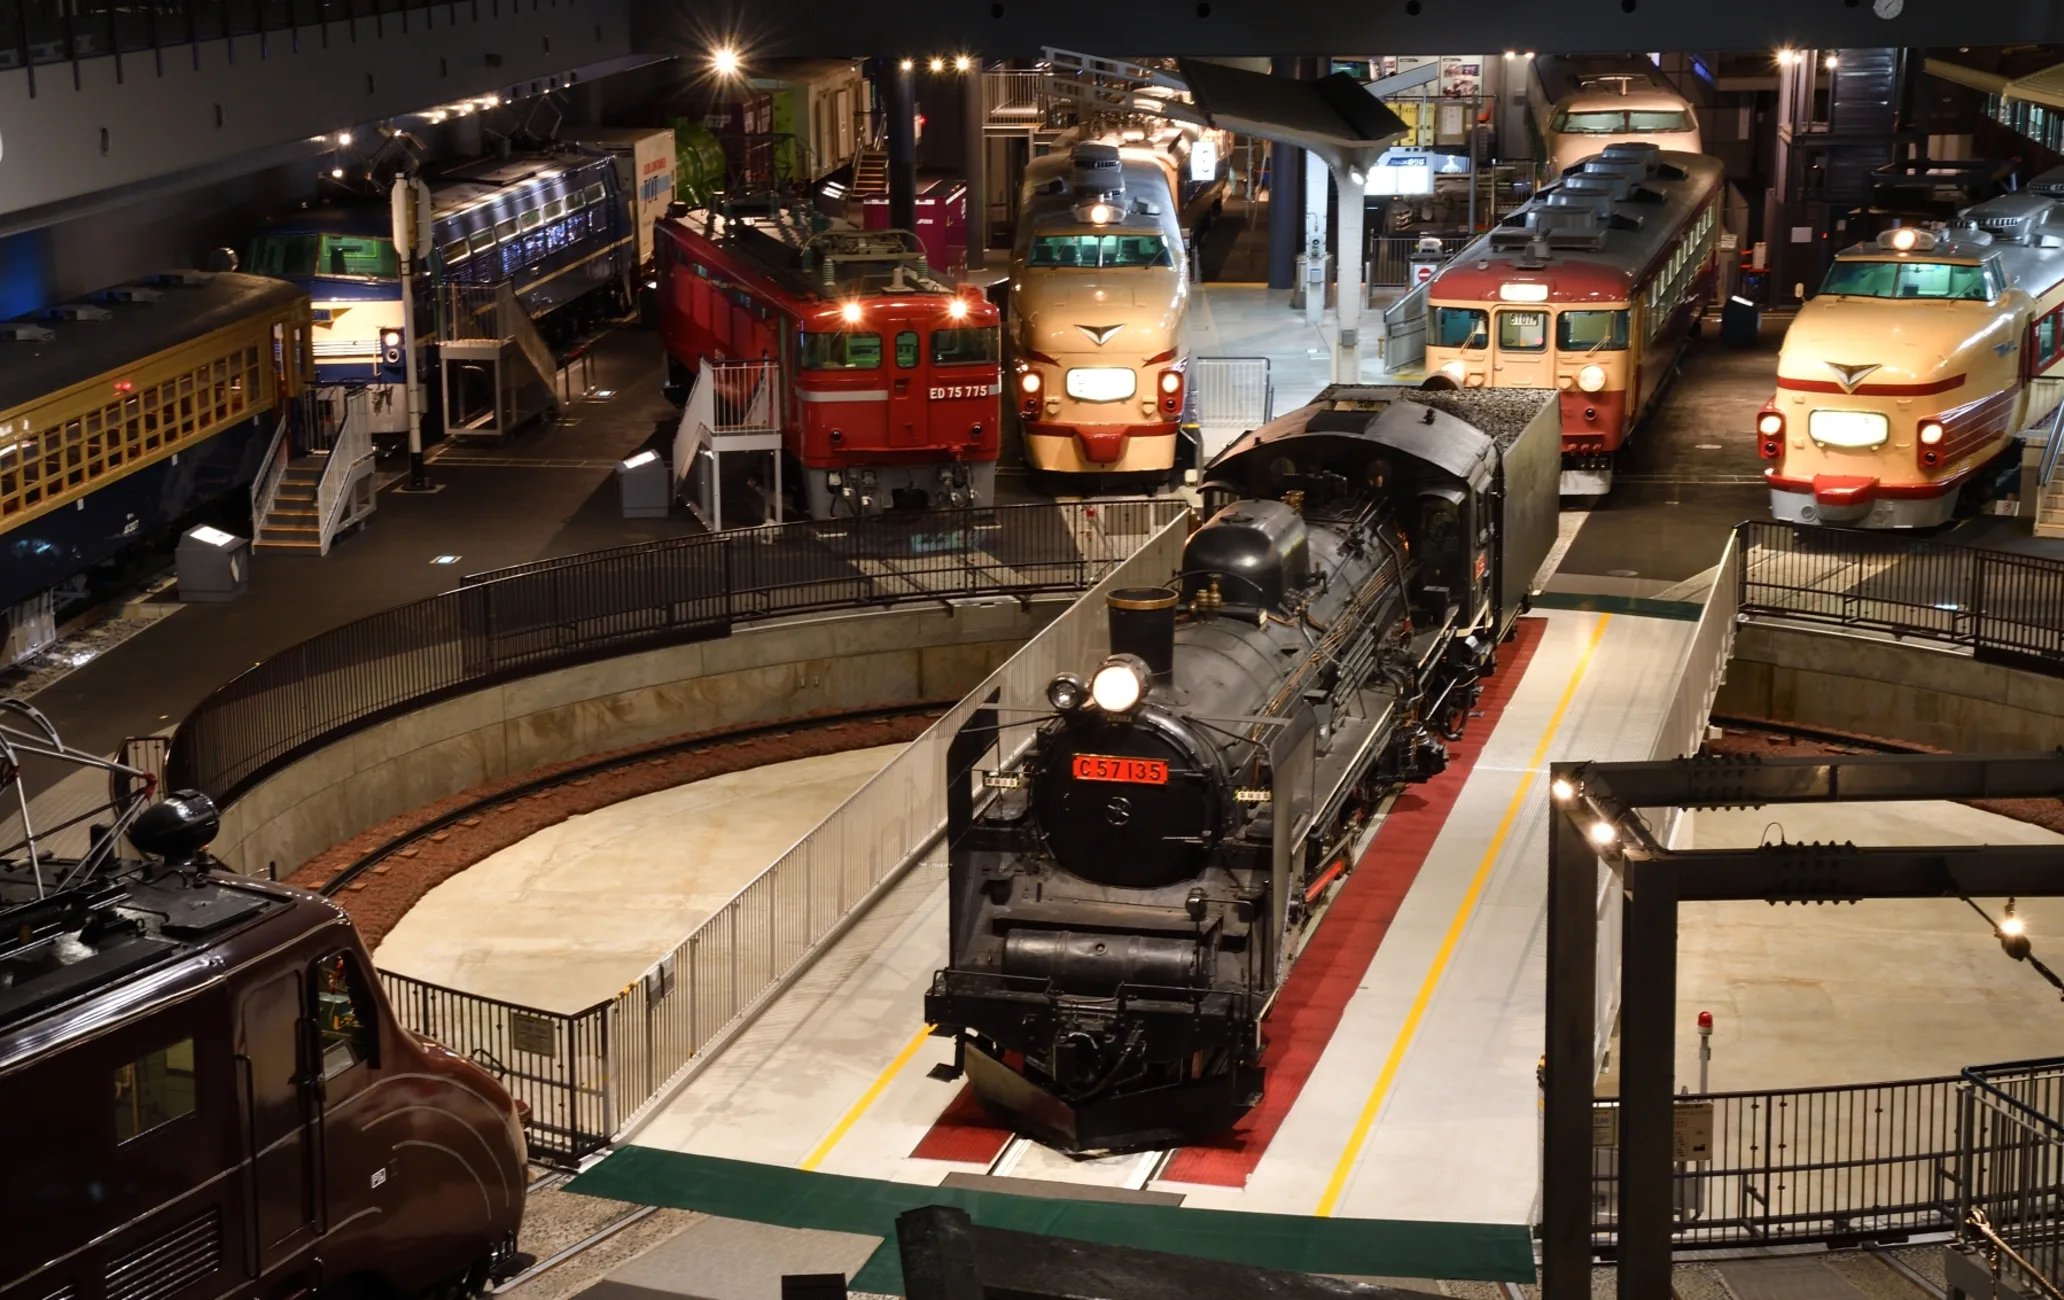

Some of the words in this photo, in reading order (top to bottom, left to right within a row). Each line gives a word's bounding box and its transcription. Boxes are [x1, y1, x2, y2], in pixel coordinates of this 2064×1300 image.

[930, 387, 946, 400] ED
[947, 386, 962, 399] 75
[965, 384, 988, 398] 775
